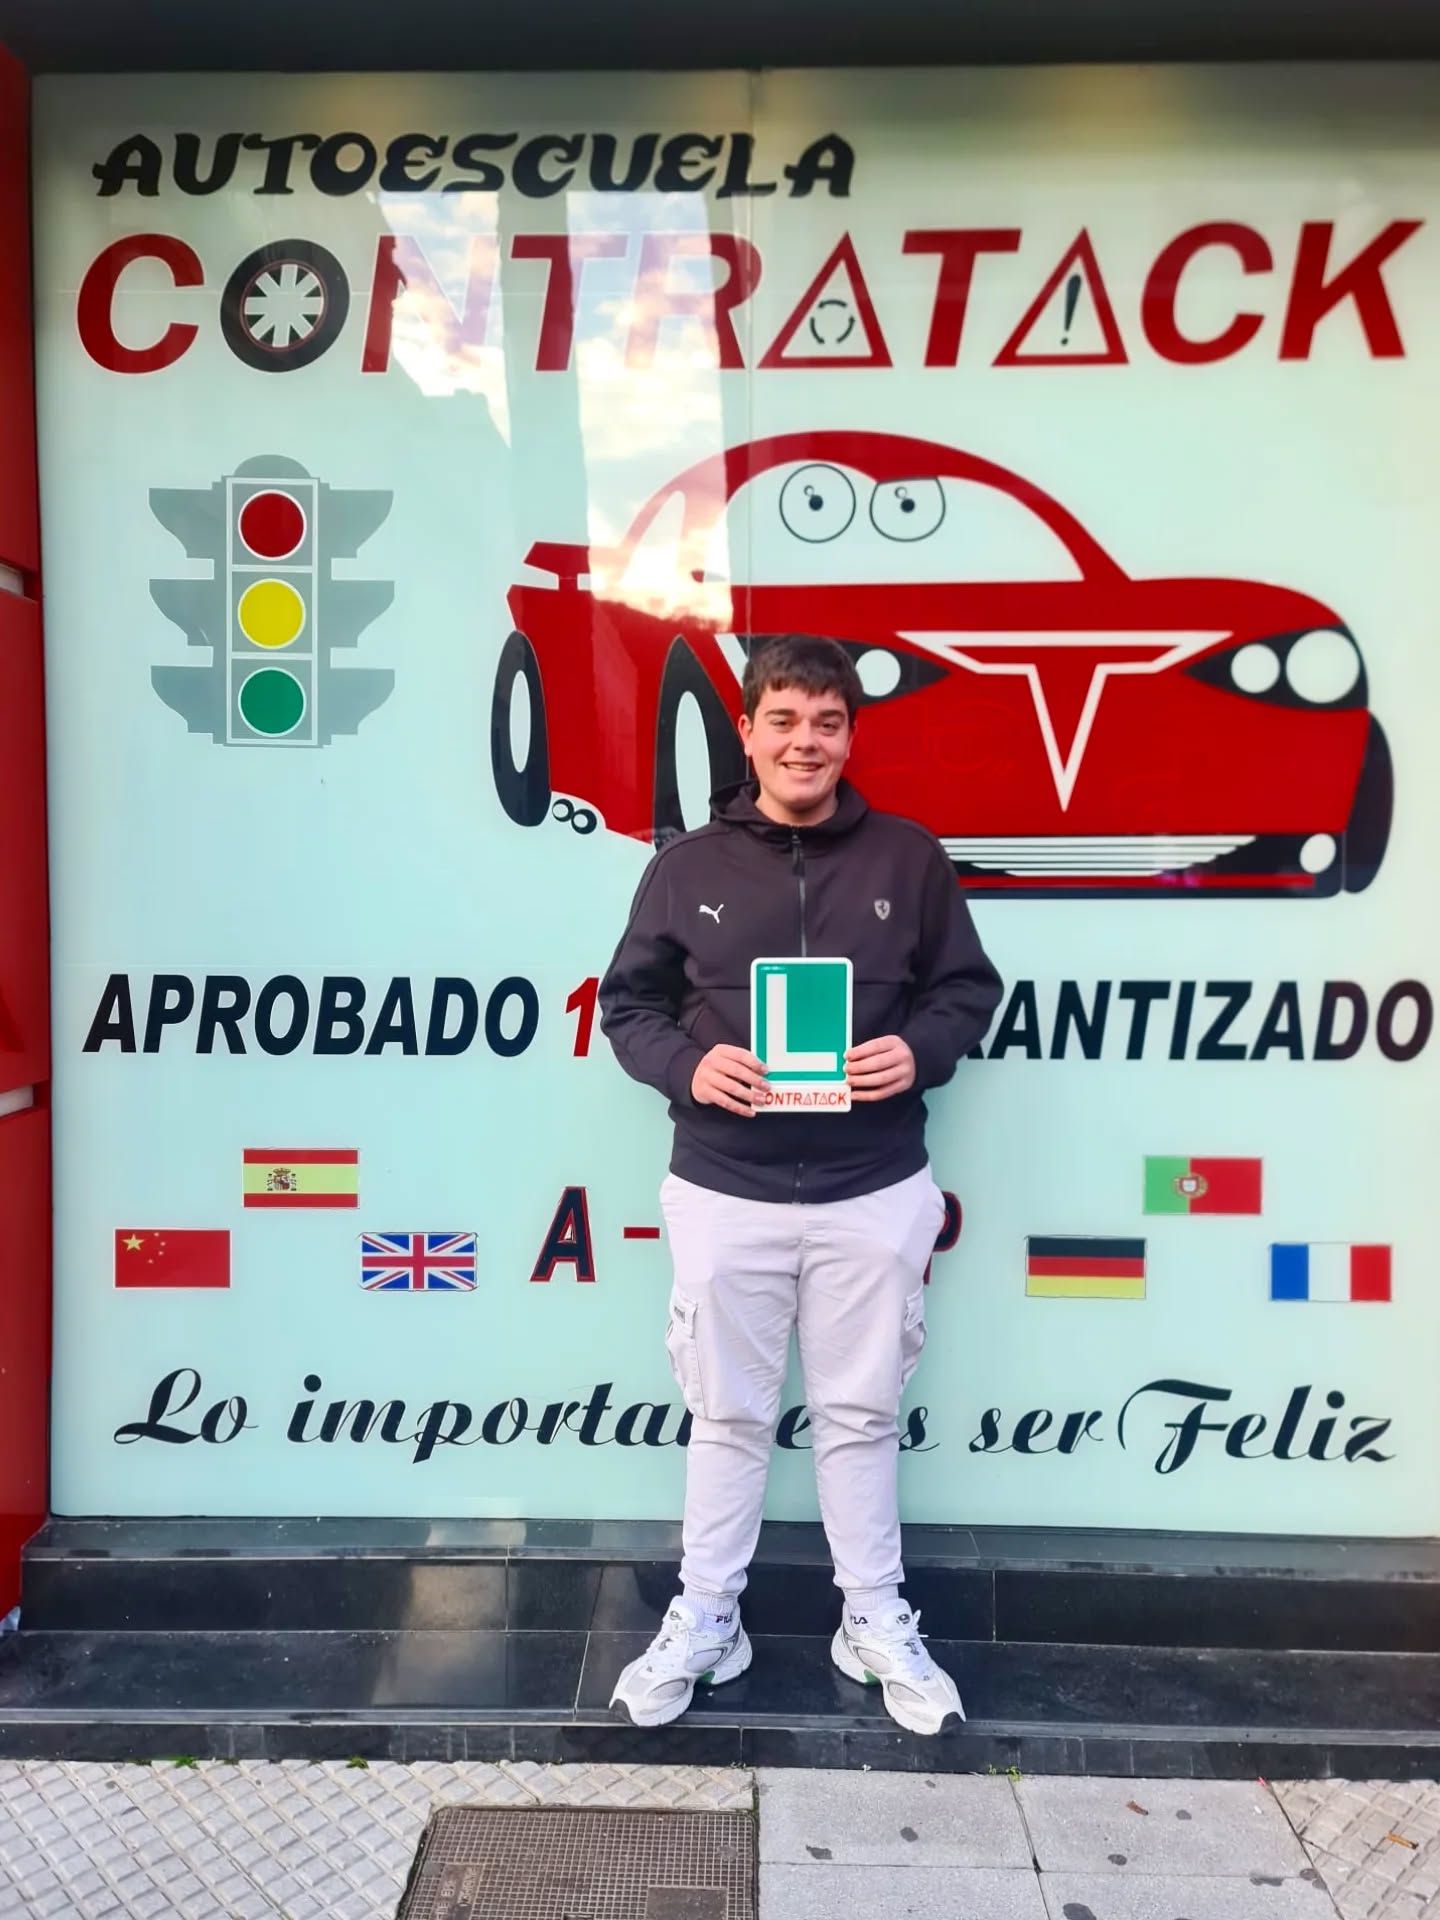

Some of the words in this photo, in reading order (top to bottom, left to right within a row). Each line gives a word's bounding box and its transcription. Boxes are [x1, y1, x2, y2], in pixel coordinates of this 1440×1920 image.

[92, 132, 856, 199] AUTOESCUELA
[82, 974, 540, 1057] APROBADO
[967, 979, 1434, 1062] ANTIZADO
[766, 973, 838, 1072] L
[764, 1091, 848, 1106] ONTRATACK
[113, 1368, 259, 1445] Lo
[969, 1406, 1104, 1454] ser
[1116, 1377, 1397, 1475] Feliz
